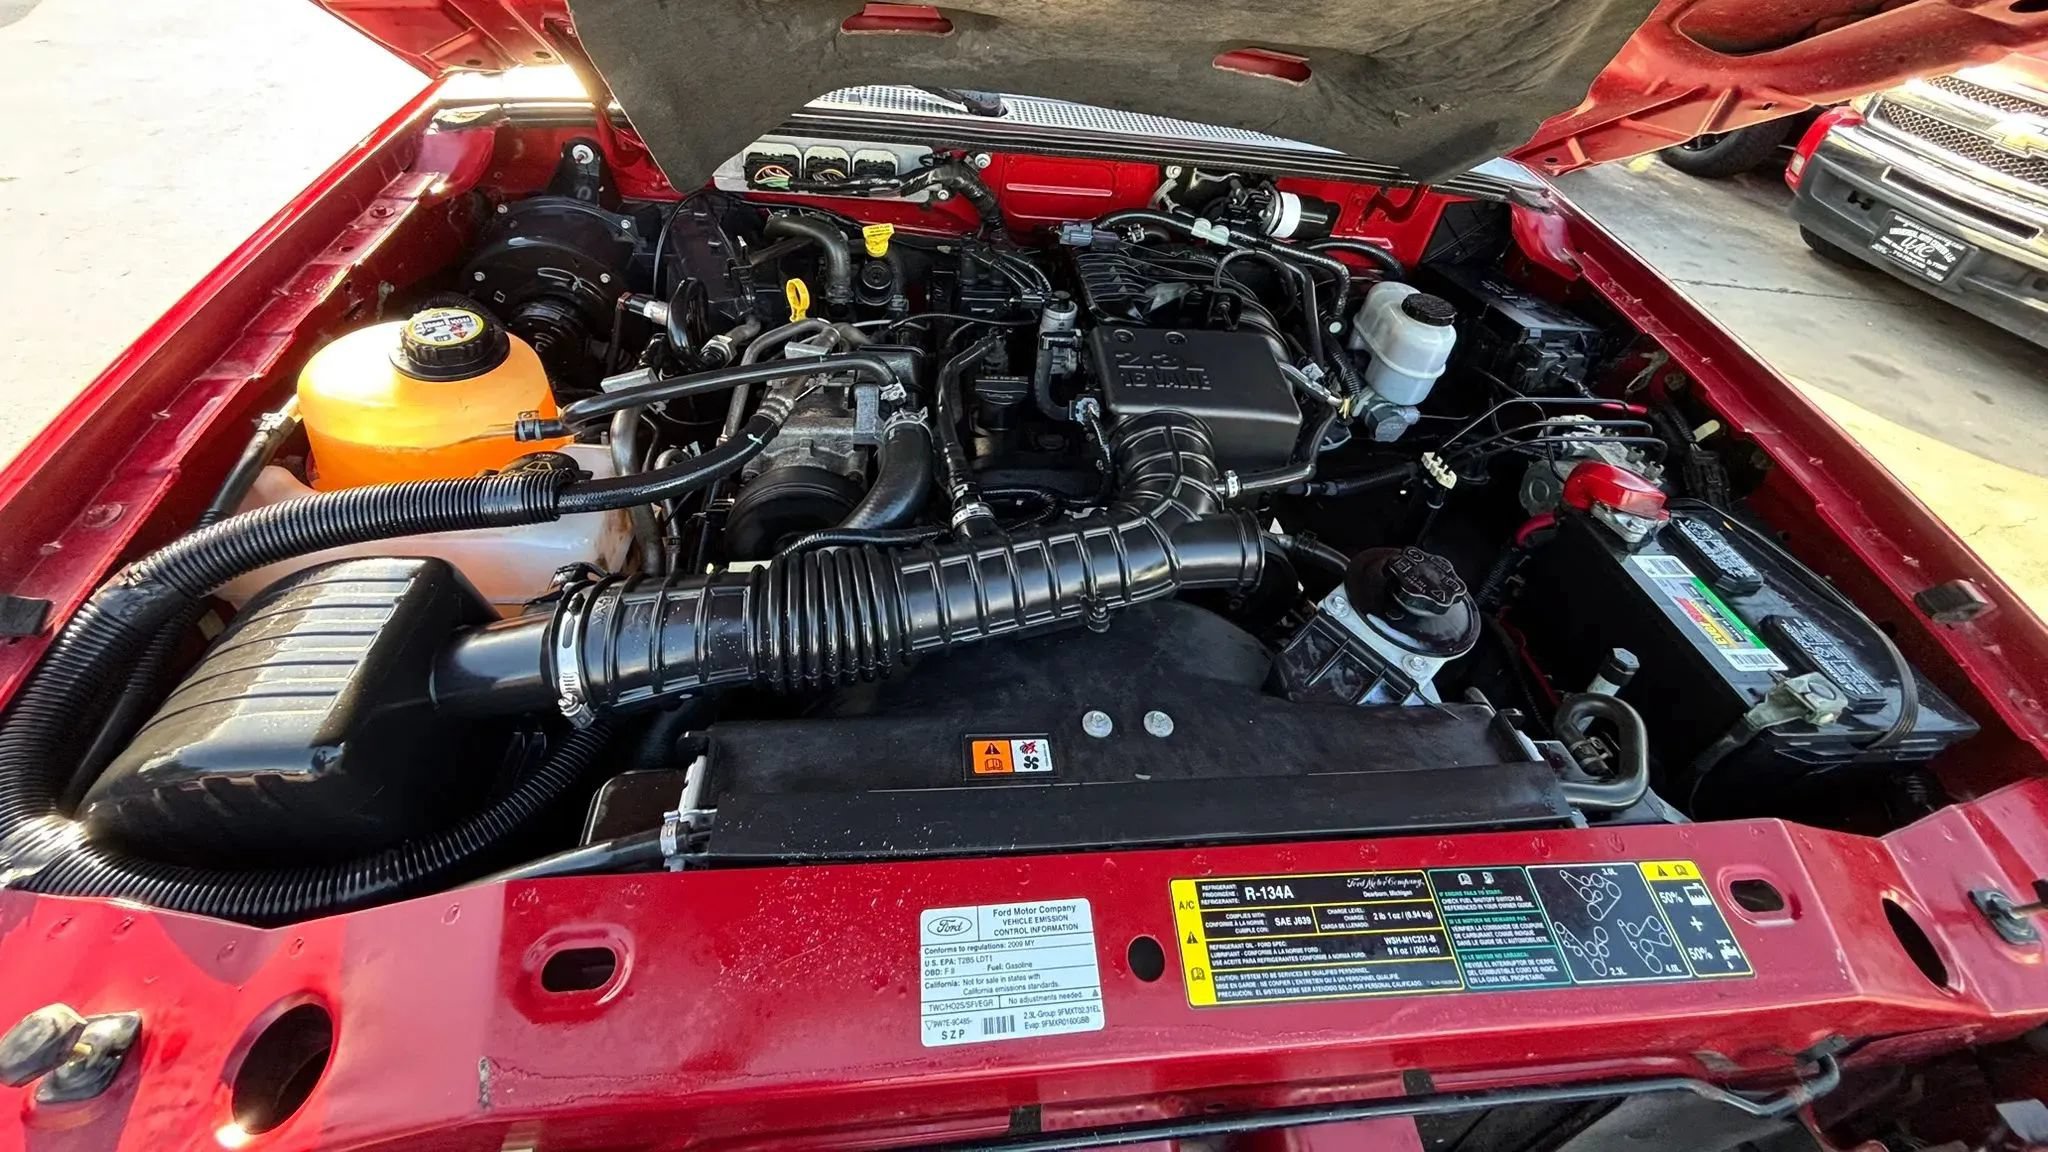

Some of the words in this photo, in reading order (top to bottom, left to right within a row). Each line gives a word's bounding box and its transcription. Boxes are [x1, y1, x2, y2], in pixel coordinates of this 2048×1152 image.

[1243, 885, 1294, 900] R-134A
[1659, 892, 1684, 904] 50%
[992, 908, 1011, 918] Ford
[1013, 906, 1036, 916] Motor
[1038, 903, 1076, 914] Company
[1179, 900, 1195, 910] A/C
[936, 918, 962, 933] Ford
[1002, 916, 1033, 925] VEHICLE
[1034, 914, 1068, 922] EMISSION
[1274, 917, 1292, 926] SAE
[1292, 916, 1312, 925] J639
[993, 926, 1028, 936] CONTROL
[1029, 923, 1078, 933] INFORMATION
[1007, 940, 1023, 948] 2009
[1688, 946, 1714, 961] 50%
[941, 1030, 947, 1040] S
[949, 1030, 956, 1039] Z
[958, 1029, 965, 1038] P
